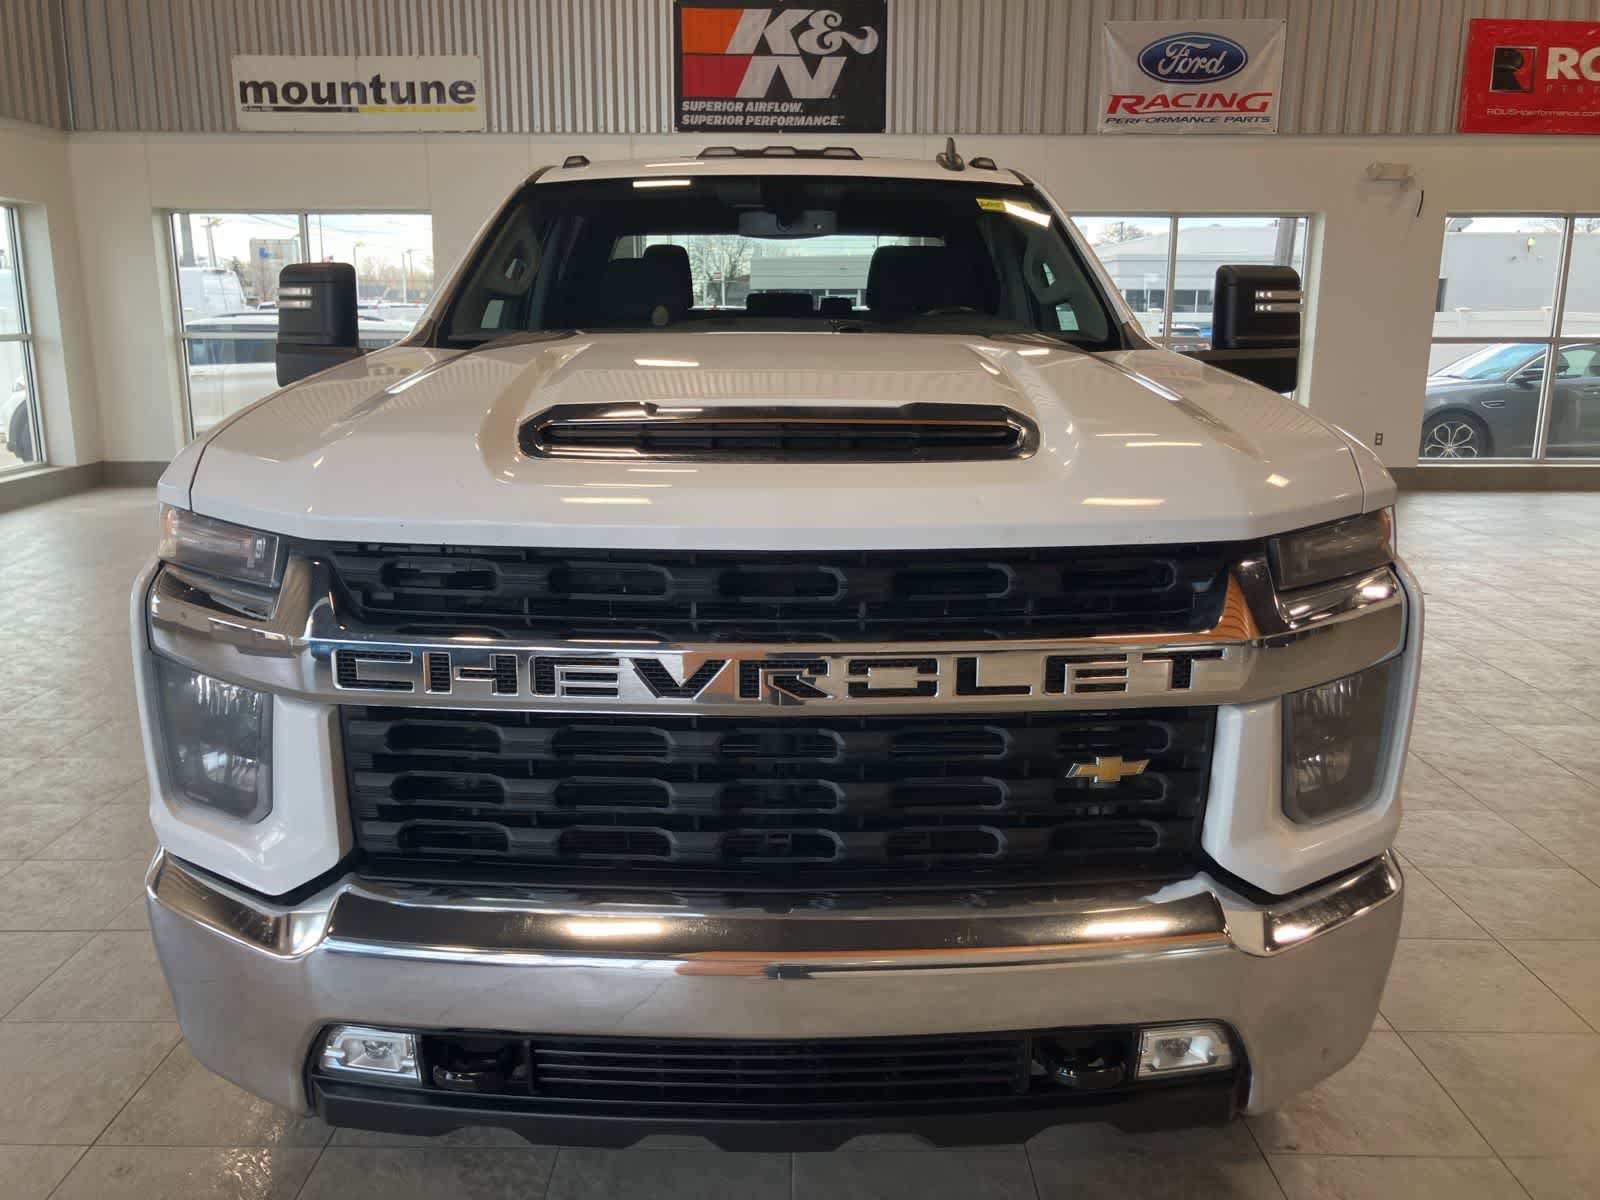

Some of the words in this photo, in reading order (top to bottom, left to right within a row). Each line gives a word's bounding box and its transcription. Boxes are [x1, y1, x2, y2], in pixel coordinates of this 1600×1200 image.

[1158, 41, 1228, 75] Ford
[239, 73, 477, 105] mountune
[681, 101, 744, 112] SUPERIOR
[745, 102, 804, 113] AIRFLOW.
[1106, 92, 1273, 115] RACING
[681, 114, 744, 126] SUPERIOR
[1105, 116, 1219, 125] PERFORMANCE
[331, 648, 1227, 702] CHEVROLET
